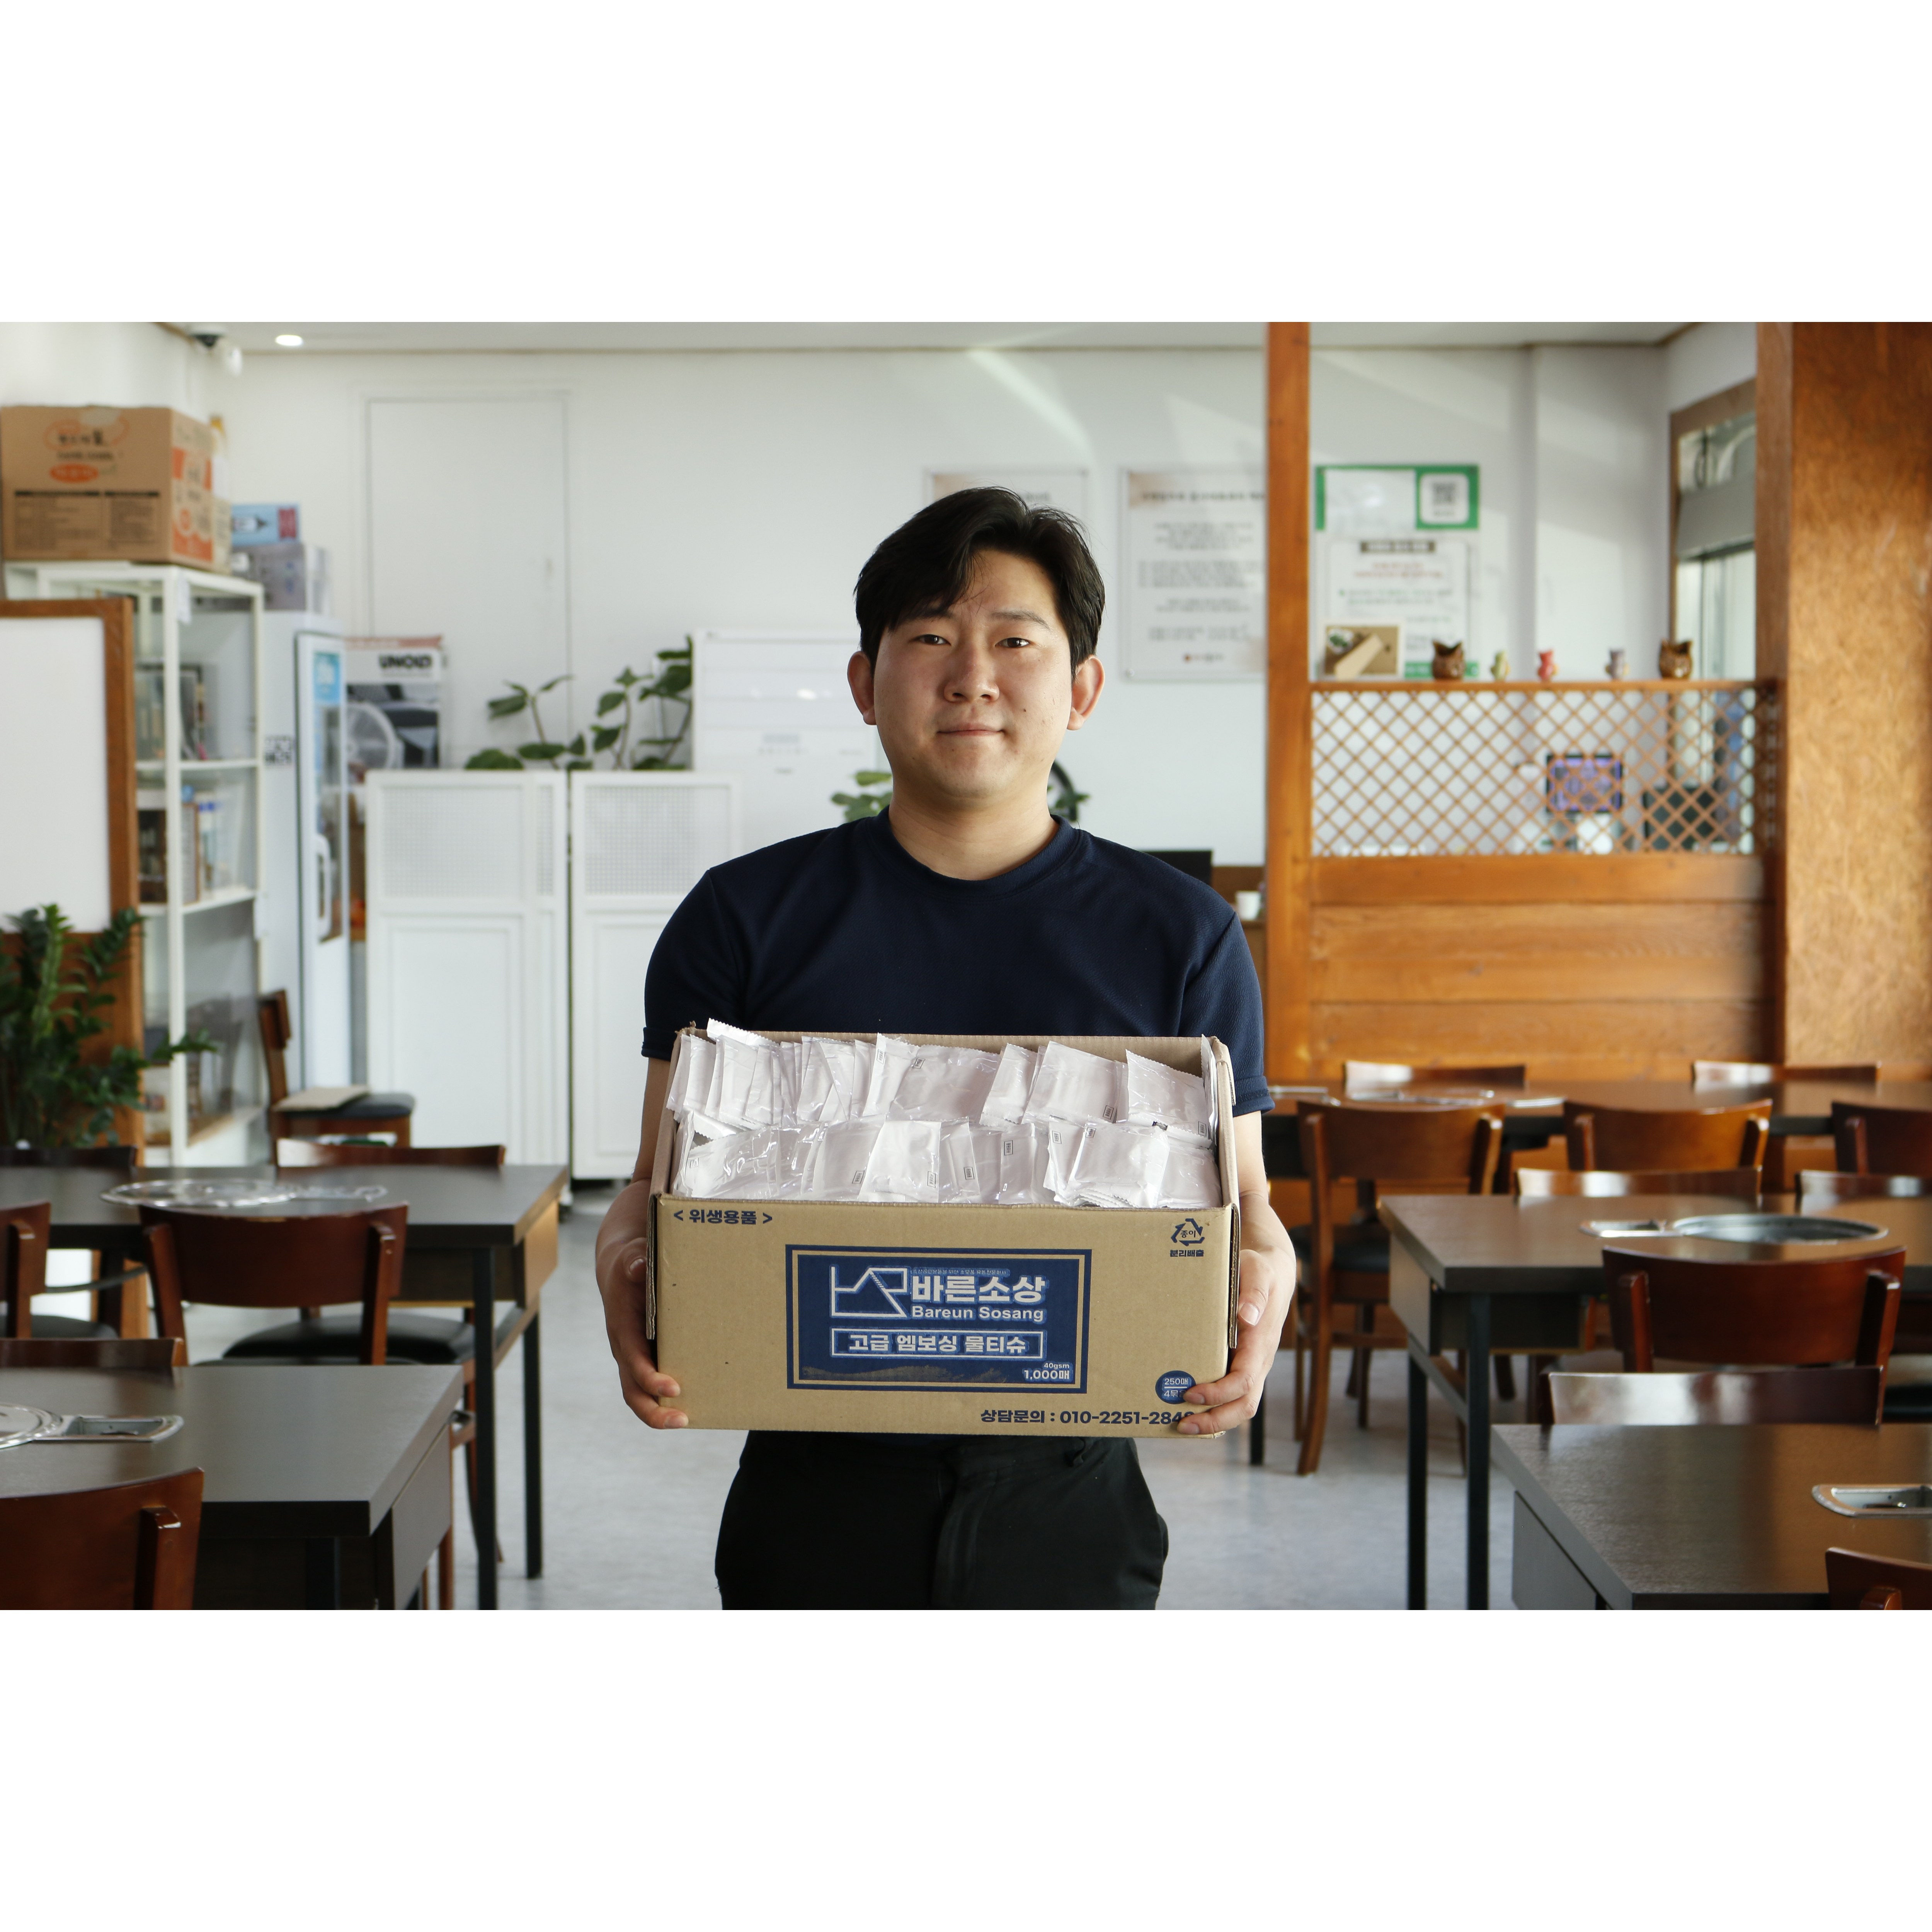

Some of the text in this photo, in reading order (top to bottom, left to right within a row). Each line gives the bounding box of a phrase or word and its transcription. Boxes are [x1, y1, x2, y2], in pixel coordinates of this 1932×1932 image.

[689, 1209, 757, 1225] 위생용품
[1180, 1230, 1196, 1238] 종이
[912, 1276, 1045, 1303] 바른소상
[912, 1306, 1043, 1322] Bareun Sosang
[849, 1335, 1026, 1353] 고급 엠보싱 물티슈
[1024, 1370, 1069, 1380] 1,000매
[980, 1409, 1045, 1423] 상담문의
